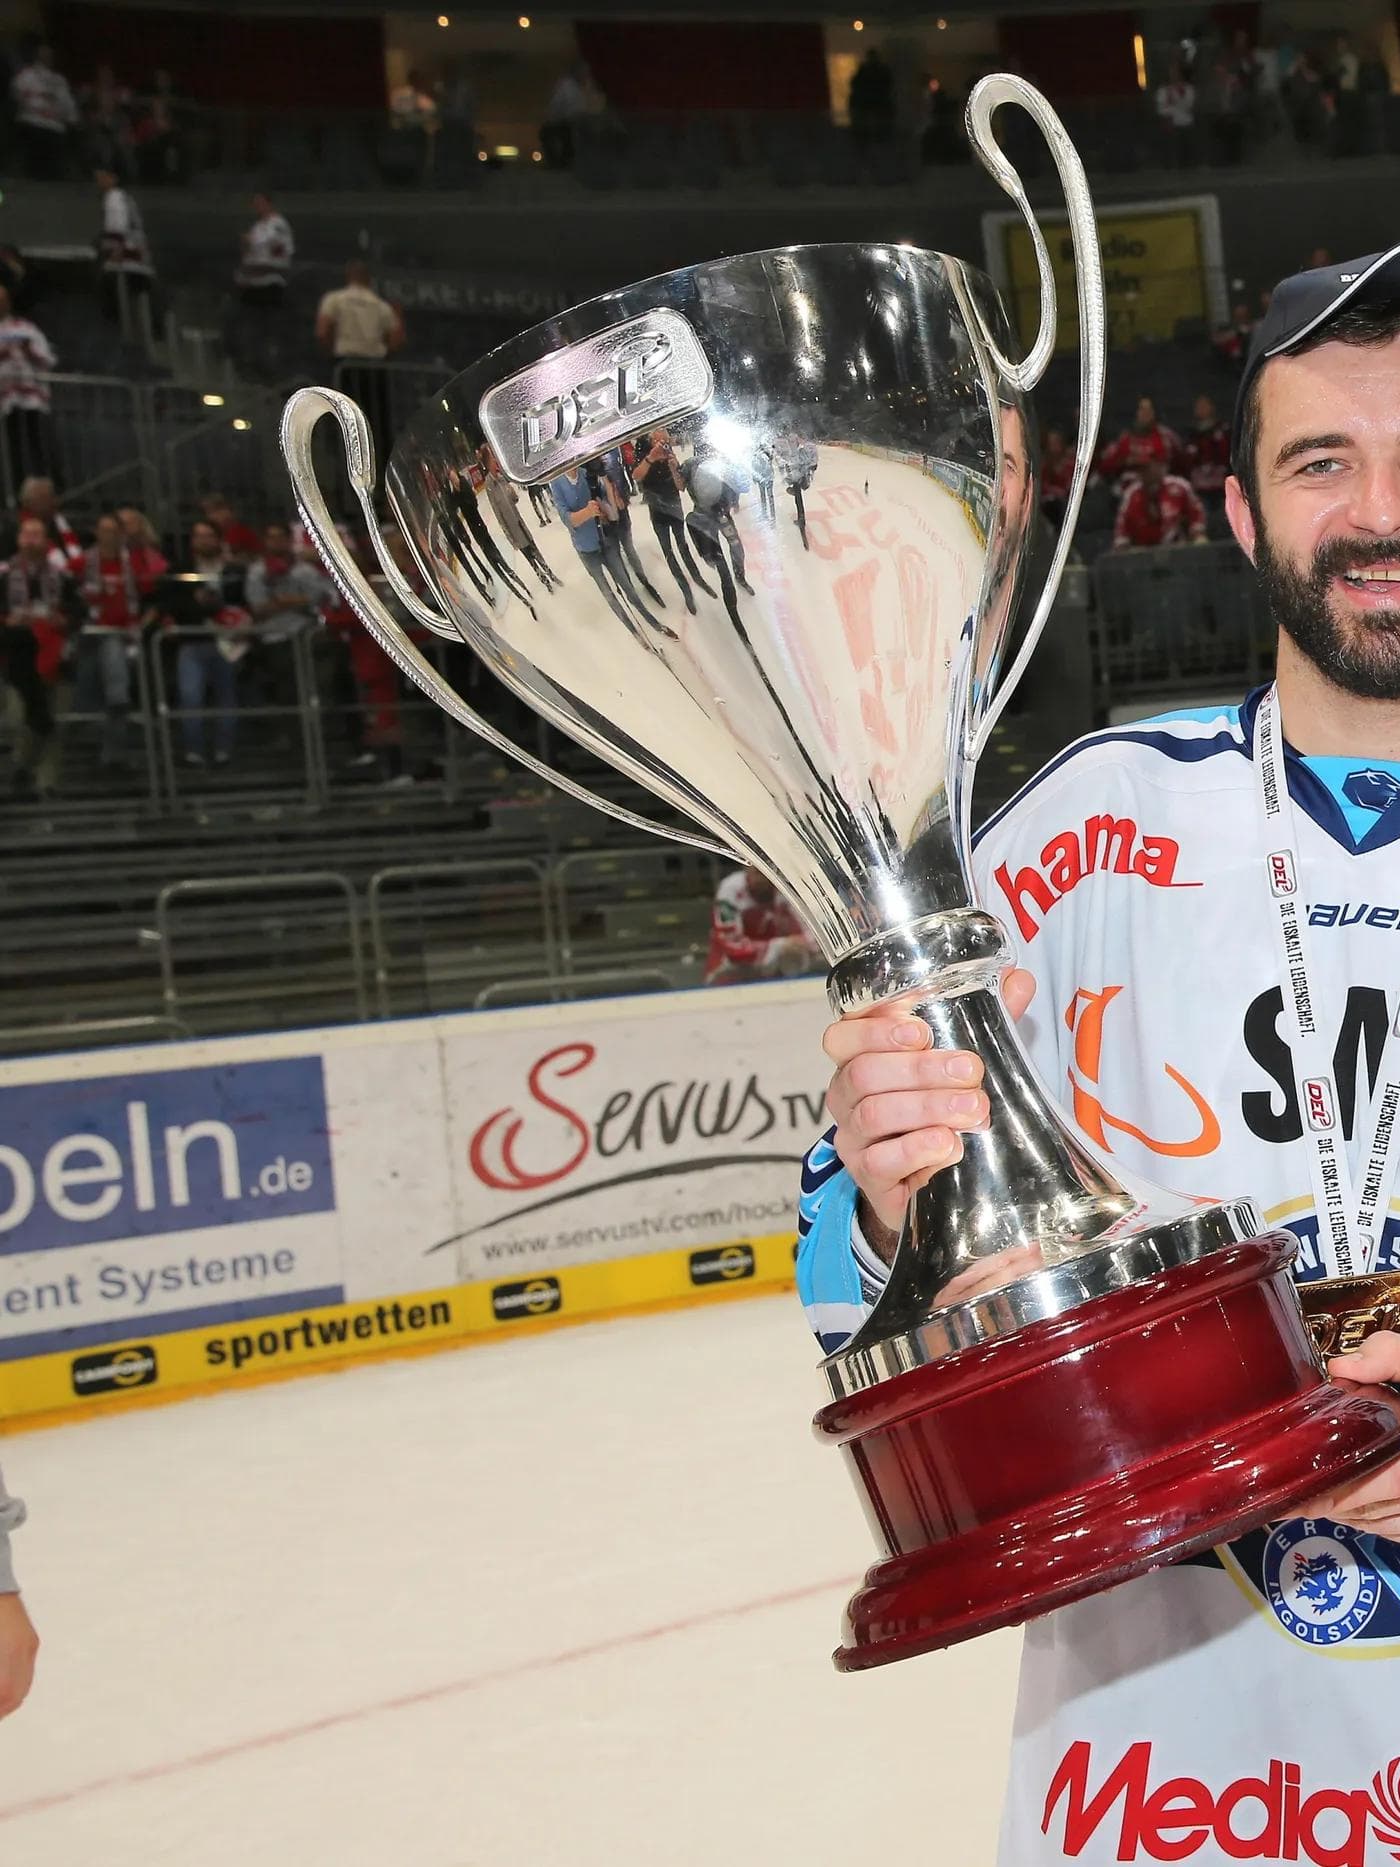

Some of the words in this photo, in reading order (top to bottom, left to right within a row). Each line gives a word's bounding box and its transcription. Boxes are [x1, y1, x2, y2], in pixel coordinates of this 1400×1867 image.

[521, 332, 674, 468] DEL
[1261, 757, 1281, 819] LEIDENSCHAFT.
[994, 813, 1204, 943] hama
[1271, 855, 1293, 893] DEL
[1280, 901, 1296, 918] DIE
[1282, 919, 1304, 964] EISKALTE
[1290, 966, 1316, 1038] LEIDENSCHAFT.
[1306, 1082, 1332, 1128] DEL
[1317, 1138, 1334, 1155] DIE
[1320, 1158, 1339, 1207] EISKALTE
[1361, 1158, 1386, 1207] EISKALTE
[481, 1197, 798, 1260] www.servustv.com/hock
[1328, 1209, 1355, 1277] LEIDENSCHAF
[1358, 1208, 1374, 1227] DIE
[0, 1272, 81, 1314] ent
[98, 1248, 297, 1305] Systeme
[205, 1300, 453, 1368] sportwetten
[1275, 1519, 1349, 1551] ERC
[1268, 1570, 1378, 1643] INGOLSTADT
